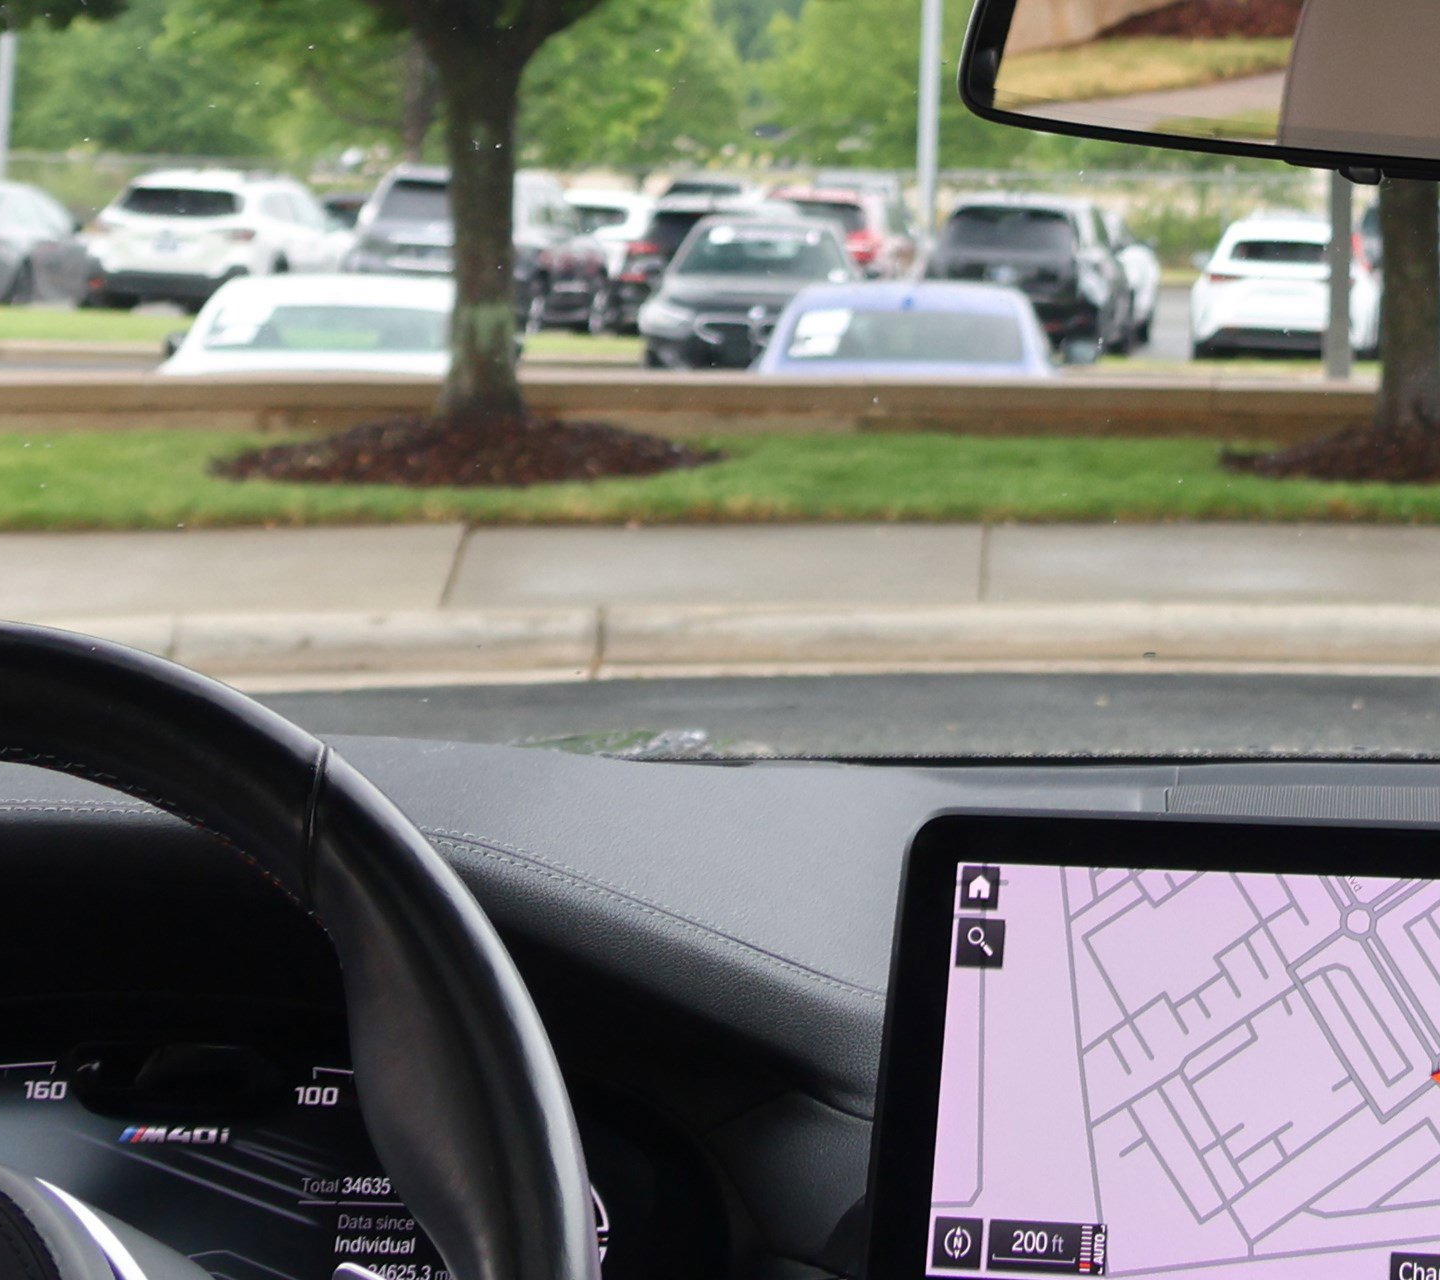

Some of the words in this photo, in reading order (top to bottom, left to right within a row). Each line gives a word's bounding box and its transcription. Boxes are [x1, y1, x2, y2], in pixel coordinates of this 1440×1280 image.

[24, 1080, 68, 1100] 160
[294, 1086, 339, 1106] 100
[300, 1177, 339, 1194] Total
[341, 1177, 391, 1195] 34635
[337, 1214, 372, 1230] Data
[376, 1215, 415, 1231] since
[334, 1235, 416, 1255] Individual
[1010, 1230, 1048, 1254] 200
[1051, 1232, 1065, 1254] ft
[1093, 1232, 1106, 1267] AUTO
